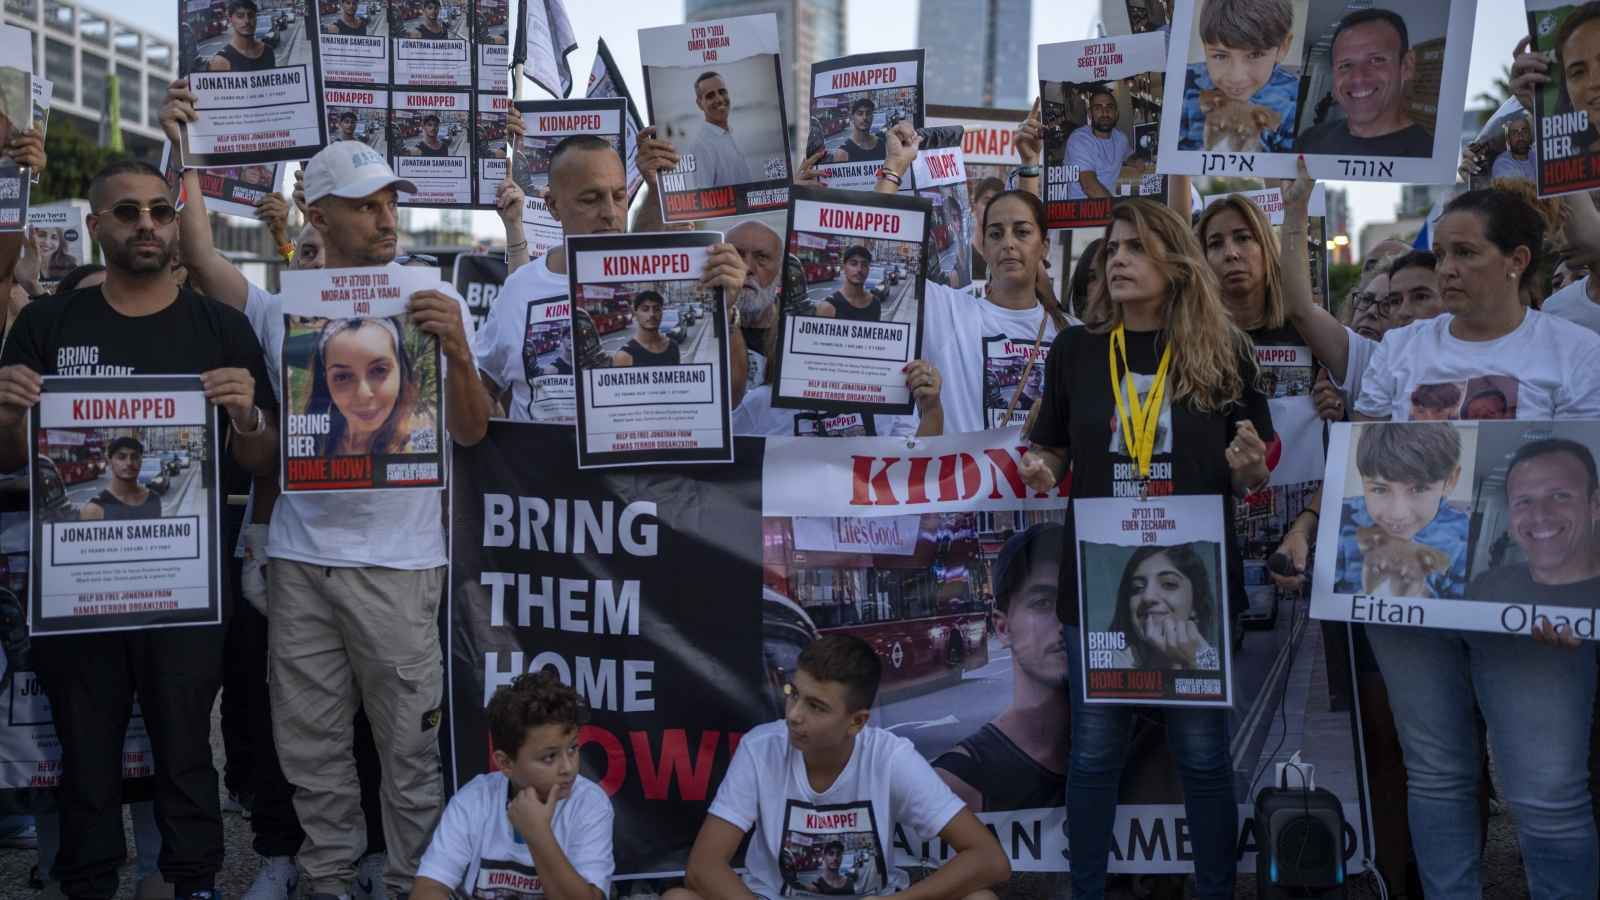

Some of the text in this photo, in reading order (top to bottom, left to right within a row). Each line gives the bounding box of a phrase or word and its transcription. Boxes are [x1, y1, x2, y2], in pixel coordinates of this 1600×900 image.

[688, 37, 730, 51] OMRI MIRAN
[1078, 54, 1123, 68] SEGEV KALFON
[196, 71, 301, 90] JONATHAN SAMERANO
[832, 67, 897, 90] KIDNAPPED
[407, 95, 455, 107] KIDNAPPED
[539, 114, 601, 132] KIDNAPPED
[1542, 110, 1589, 138] BRING
[1543, 135, 1572, 160] HER
[1048, 164, 1080, 183] BRING
[1201, 152, 1394, 177] איתן אוהד
[662, 174, 687, 192] HIM
[1048, 183, 1068, 201] HIM
[665, 192, 697, 214] HOME
[700, 185, 736, 208] NOW!
[1048, 199, 1112, 219] HOME NOW!
[819, 207, 900, 234] KIDNAPPED
[603, 254, 689, 276] KIDNAPPED
[321, 286, 401, 302] MORAN STELA YANAI
[799, 321, 903, 342] JONATHAN SAMERANO
[57, 345, 99, 368] BRING
[598, 370, 706, 387] JONATHAN SAMERANO
[808, 379, 882, 393] HELP US FREE JONATHAN FROM
[802, 390, 886, 403] HAMAS TERROR ORGANIZATION
[72, 398, 176, 421] KIDNAPPED
[288, 414, 331, 435] BRING
[612, 440, 698, 450] HAMAS TERROR ORGANIZATION
[616, 430, 692, 441] HELP US FREE JONATHAN FROM
[288, 436, 316, 457] HER
[288, 455, 373, 480] HOME NOW!
[850, 445, 1072, 506] KIDN
[1149, 462, 1172, 480] EDEN
[1113, 481, 1142, 497] HOME
[60, 523, 191, 543] JONATHAN SAMERANO
[482, 493, 659, 557] BRING
[1122, 519, 1176, 531] EDEN ZECHARYA
[78, 589, 172, 602] HELP US FREE JONATHAN FROM
[480, 571, 641, 636] THEM
[73, 599, 179, 616] HAMAS TERROR ORGANIZATION
[1350, 595, 1596, 638] Eitan Ohad
[1088, 631, 1126, 650] BRING
[1089, 650, 1113, 669] HER
[483, 651, 656, 713] HOME
[1090, 671, 1124, 689] HOME
[1127, 671, 1163, 689] NOW!
[488, 872, 544, 890] KIDNAPPED
